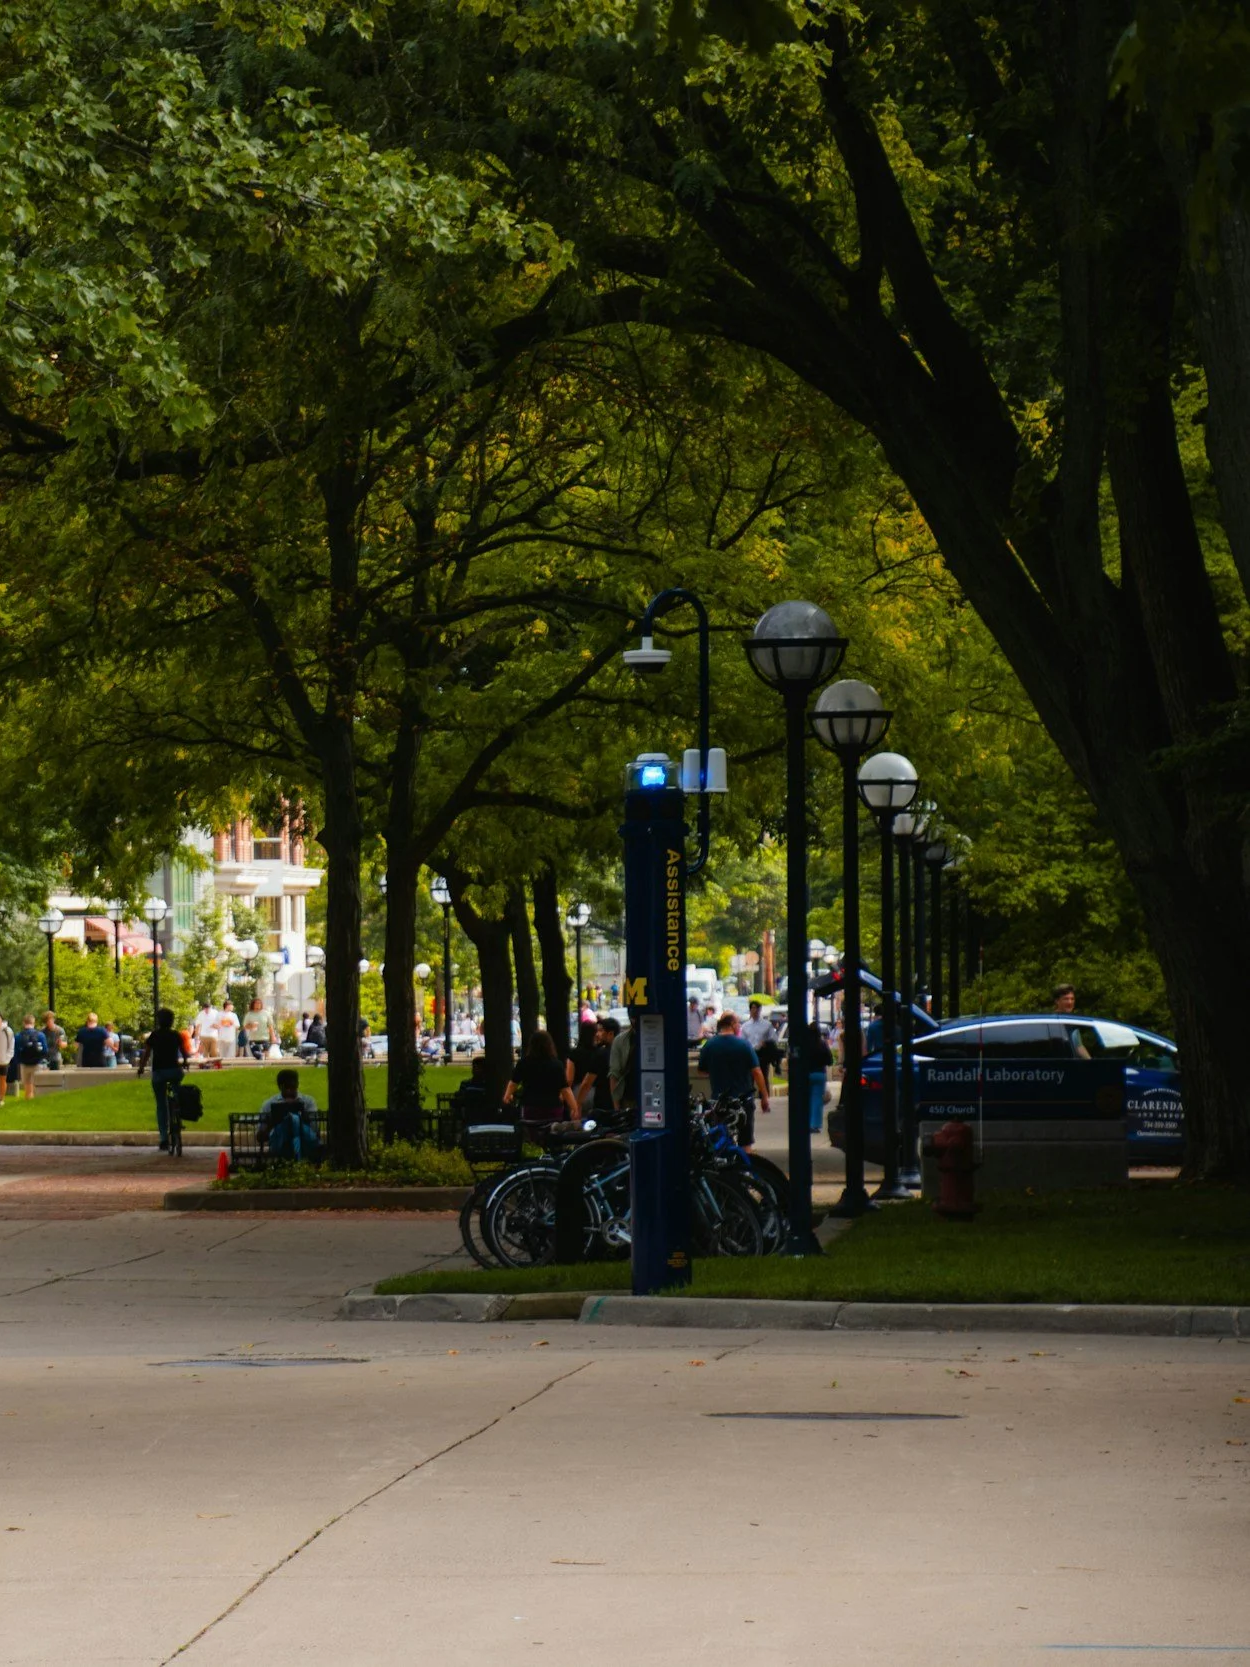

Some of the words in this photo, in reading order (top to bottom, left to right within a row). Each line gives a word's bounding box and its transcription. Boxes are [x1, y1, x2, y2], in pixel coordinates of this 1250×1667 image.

[666, 848, 681, 972] Assistance
[623, 977, 648, 1005] M
[926, 1067, 981, 1082] Randall
[985, 1067, 1065, 1085] Laboratory
[928, 1105, 945, 1114] 450
[946, 1104, 976, 1114] Church
[1127, 1099, 1184, 1112] CLARENDA
